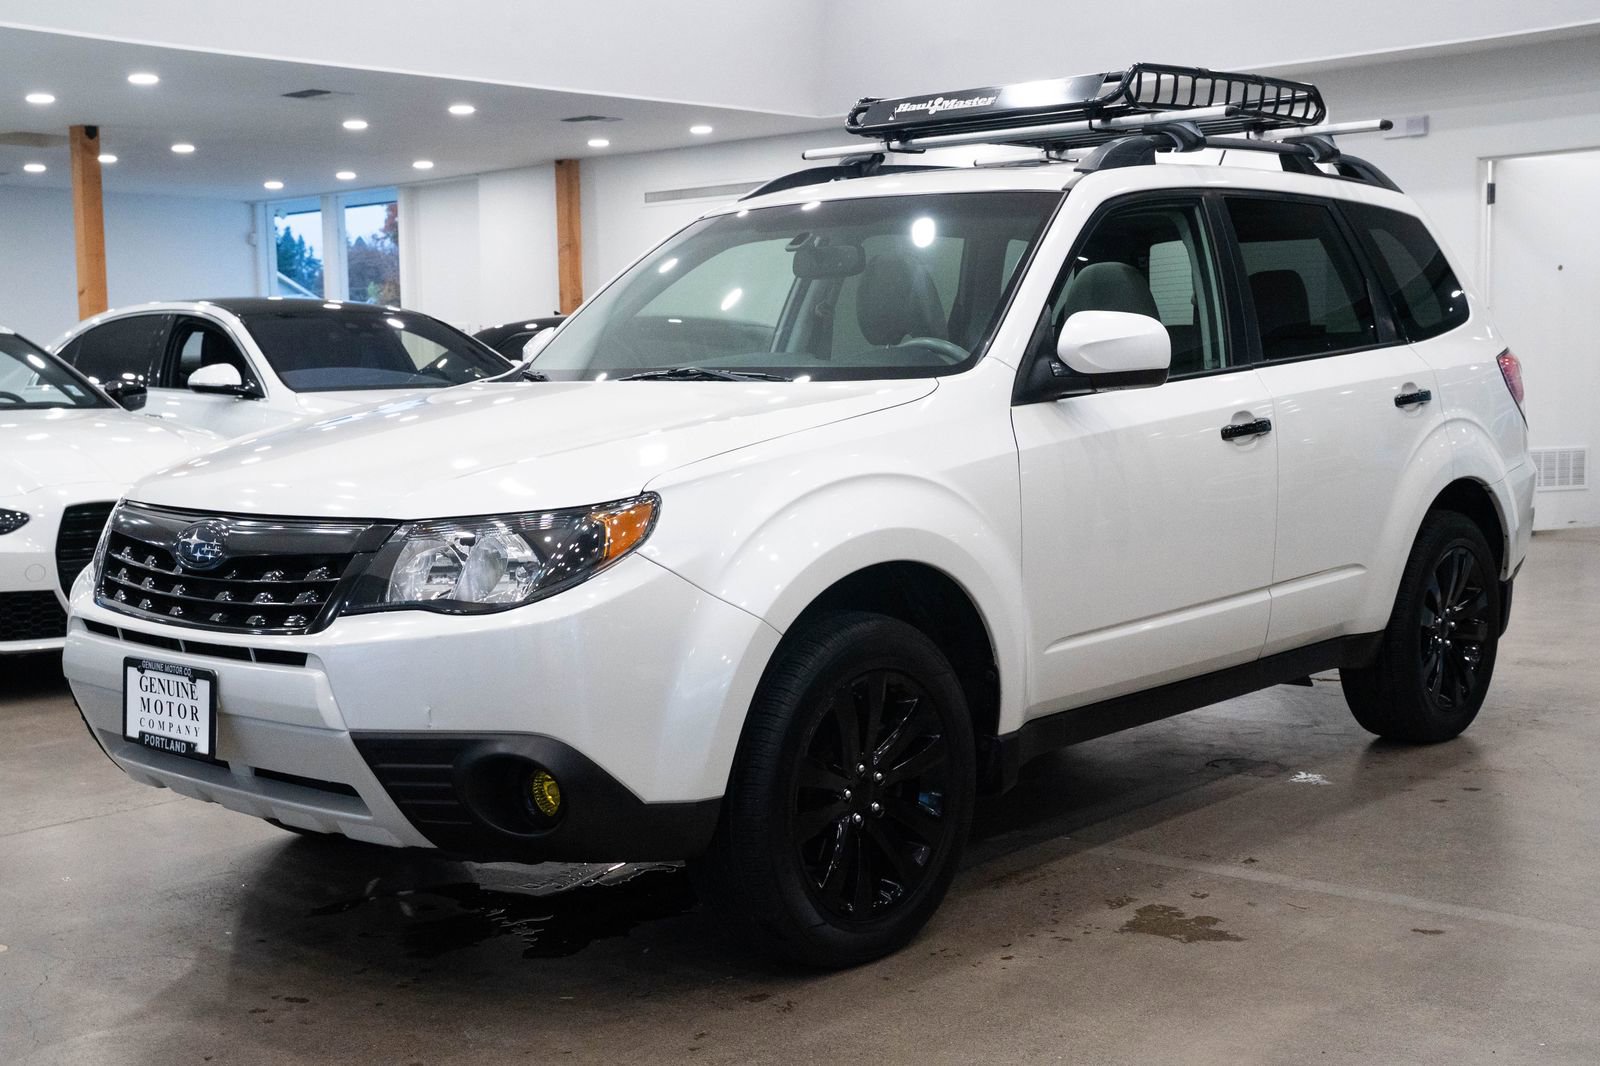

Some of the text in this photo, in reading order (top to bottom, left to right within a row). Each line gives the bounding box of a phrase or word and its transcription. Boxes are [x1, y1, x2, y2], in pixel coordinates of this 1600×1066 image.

[941, 96, 997, 111] Master
[142, 660, 163, 672] GENUINE
[164, 664, 183, 675] MOTOR
[139, 675, 198, 701] GENUINE
[140, 696, 200, 722] MOTOR
[139, 717, 200, 737] COMPANY
[144, 734, 187, 753] PORTLAND
